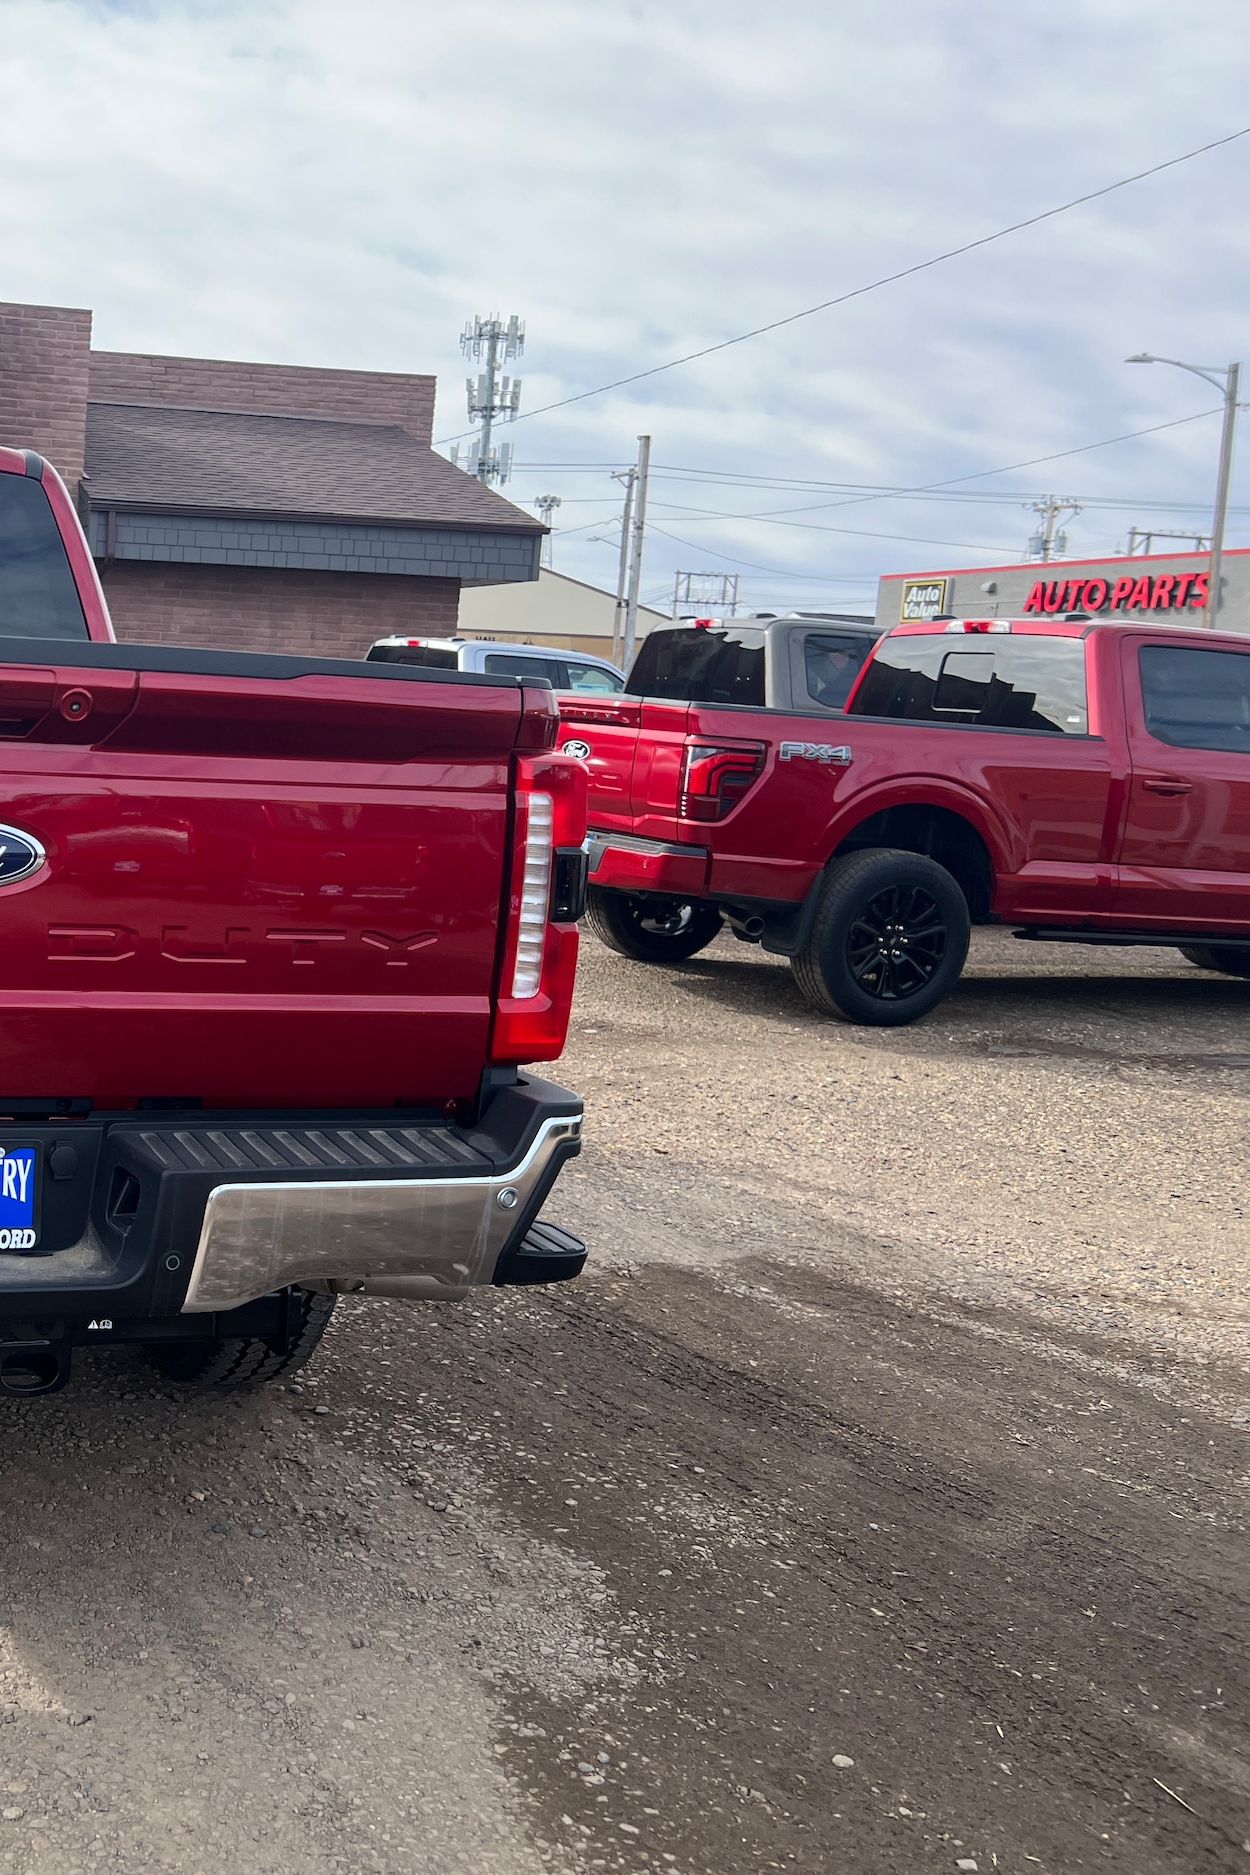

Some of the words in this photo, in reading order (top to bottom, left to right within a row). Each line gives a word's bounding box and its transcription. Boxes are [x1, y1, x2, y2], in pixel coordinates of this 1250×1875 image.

[905, 585, 940, 602] Auto
[1023, 578, 1108, 613] AUTO
[1110, 571, 1211, 610] PARTS
[903, 602, 940, 618] Value
[779, 741, 851, 763] FX4
[47, 922, 440, 967] DUTY
